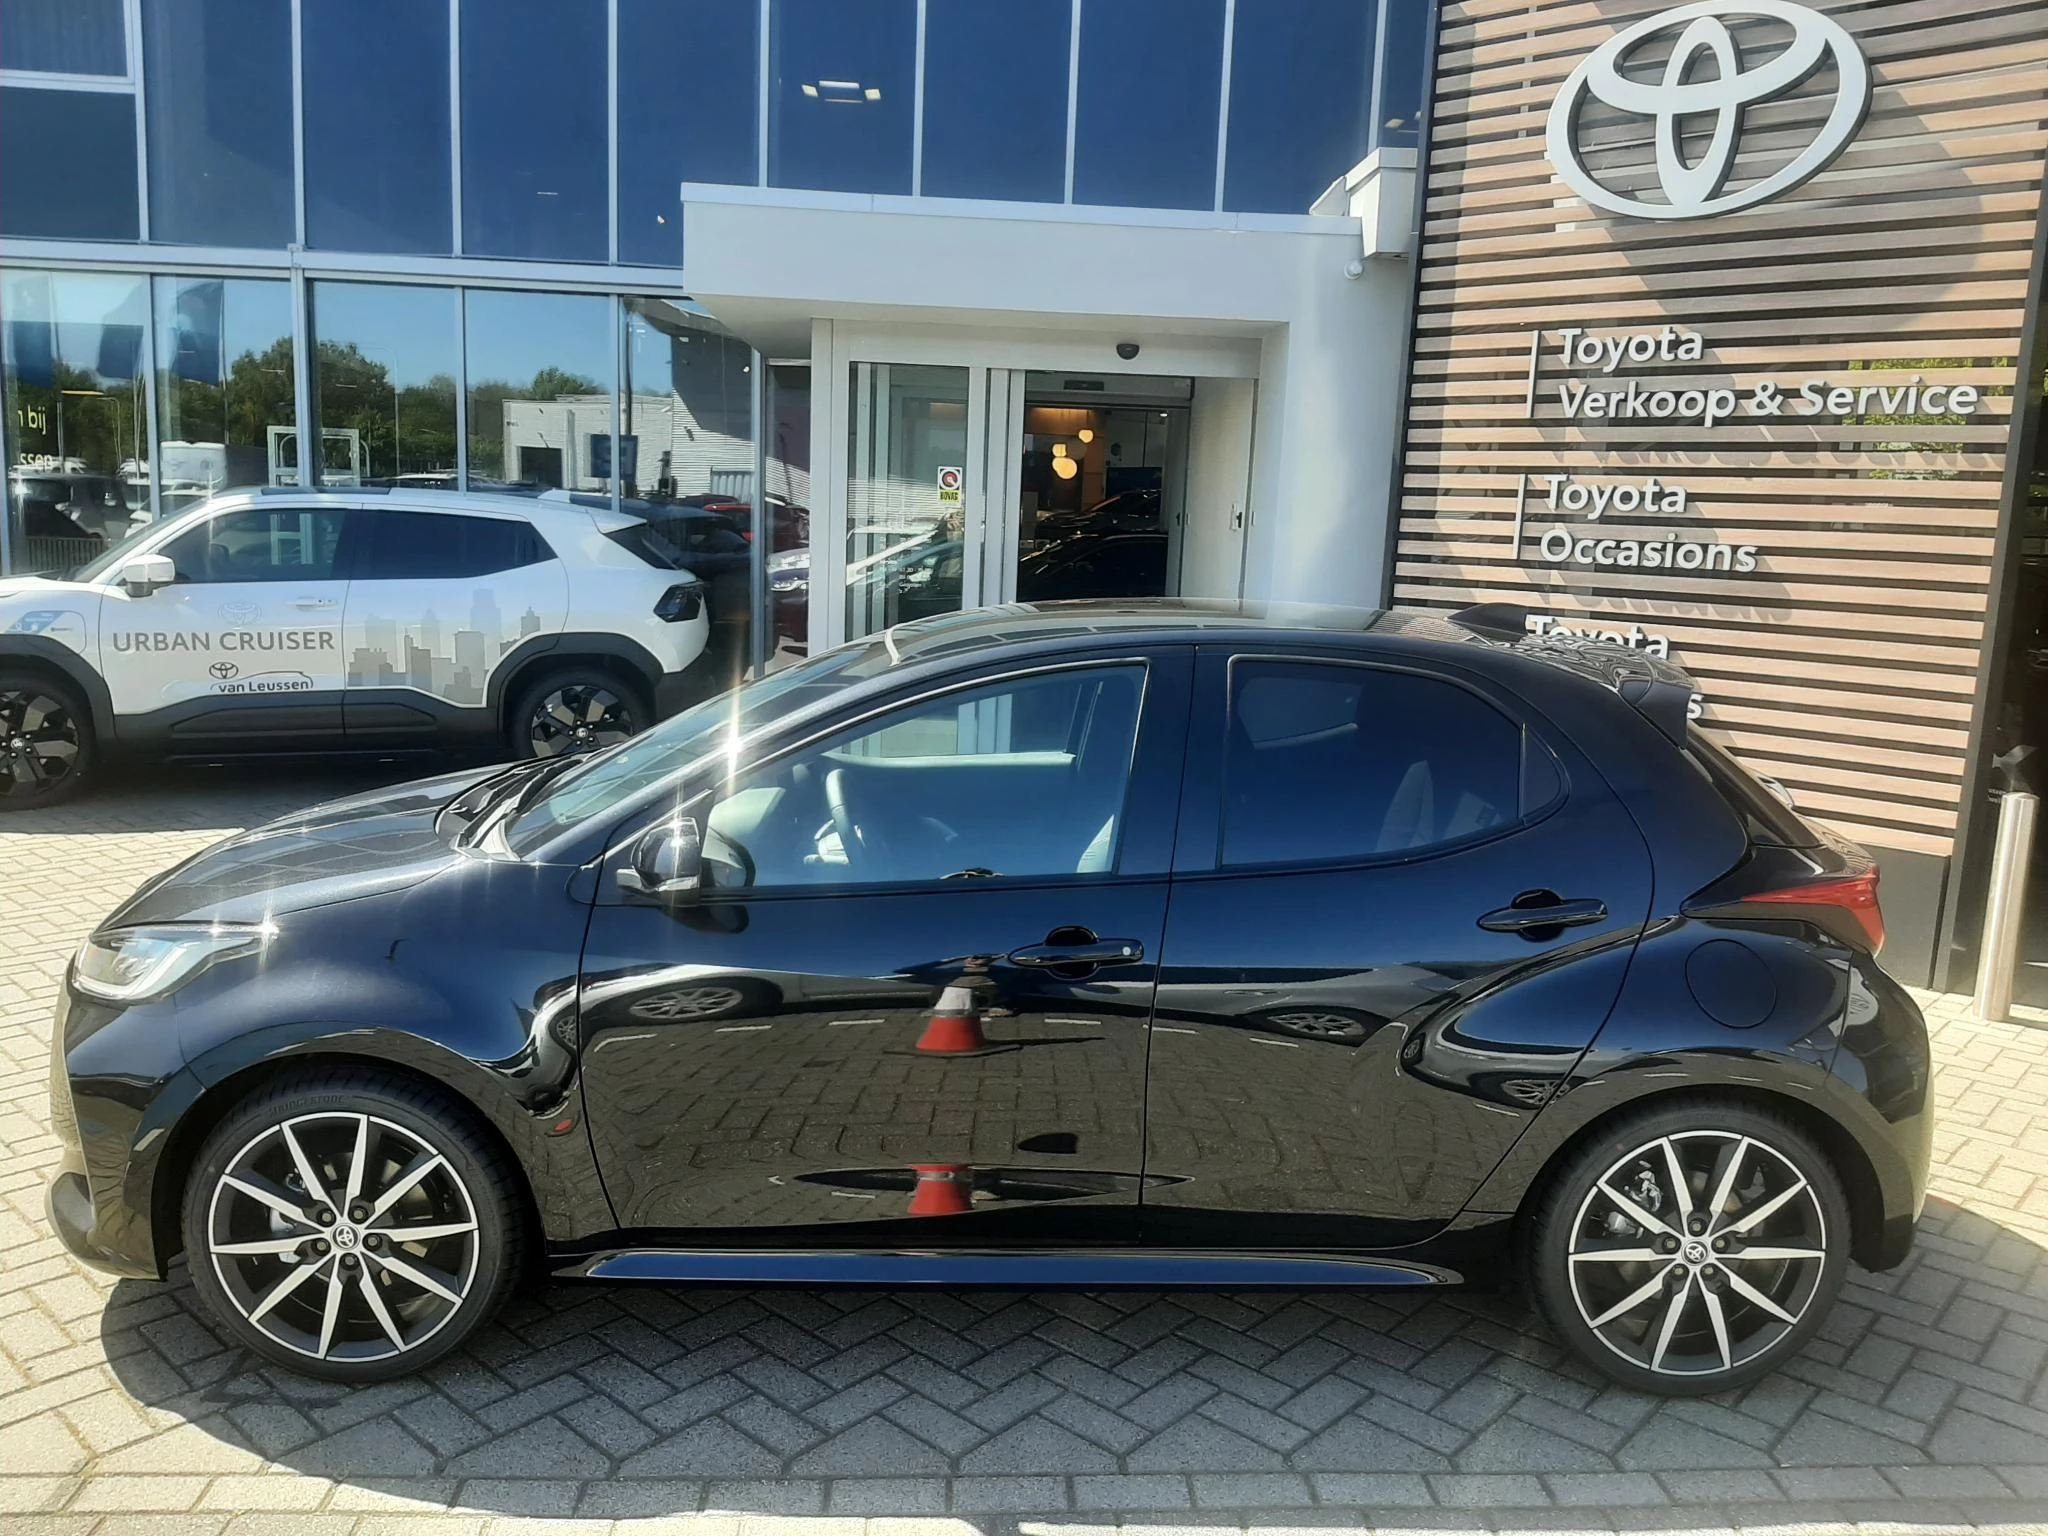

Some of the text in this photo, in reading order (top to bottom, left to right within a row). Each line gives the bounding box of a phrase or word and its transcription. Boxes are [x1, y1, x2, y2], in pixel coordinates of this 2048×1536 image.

[1558, 326, 1704, 373] Toyota
[27, 403, 47, 436] bij
[1558, 374, 1978, 428] Verkoop & Service
[1543, 473, 1687, 520] Toyota
[1540, 527, 1758, 573] Occasions
[112, 631, 335, 651] URBAN CRUISER
[1525, 613, 1670, 660] Tota
[218, 681, 310, 694] van Leussen
